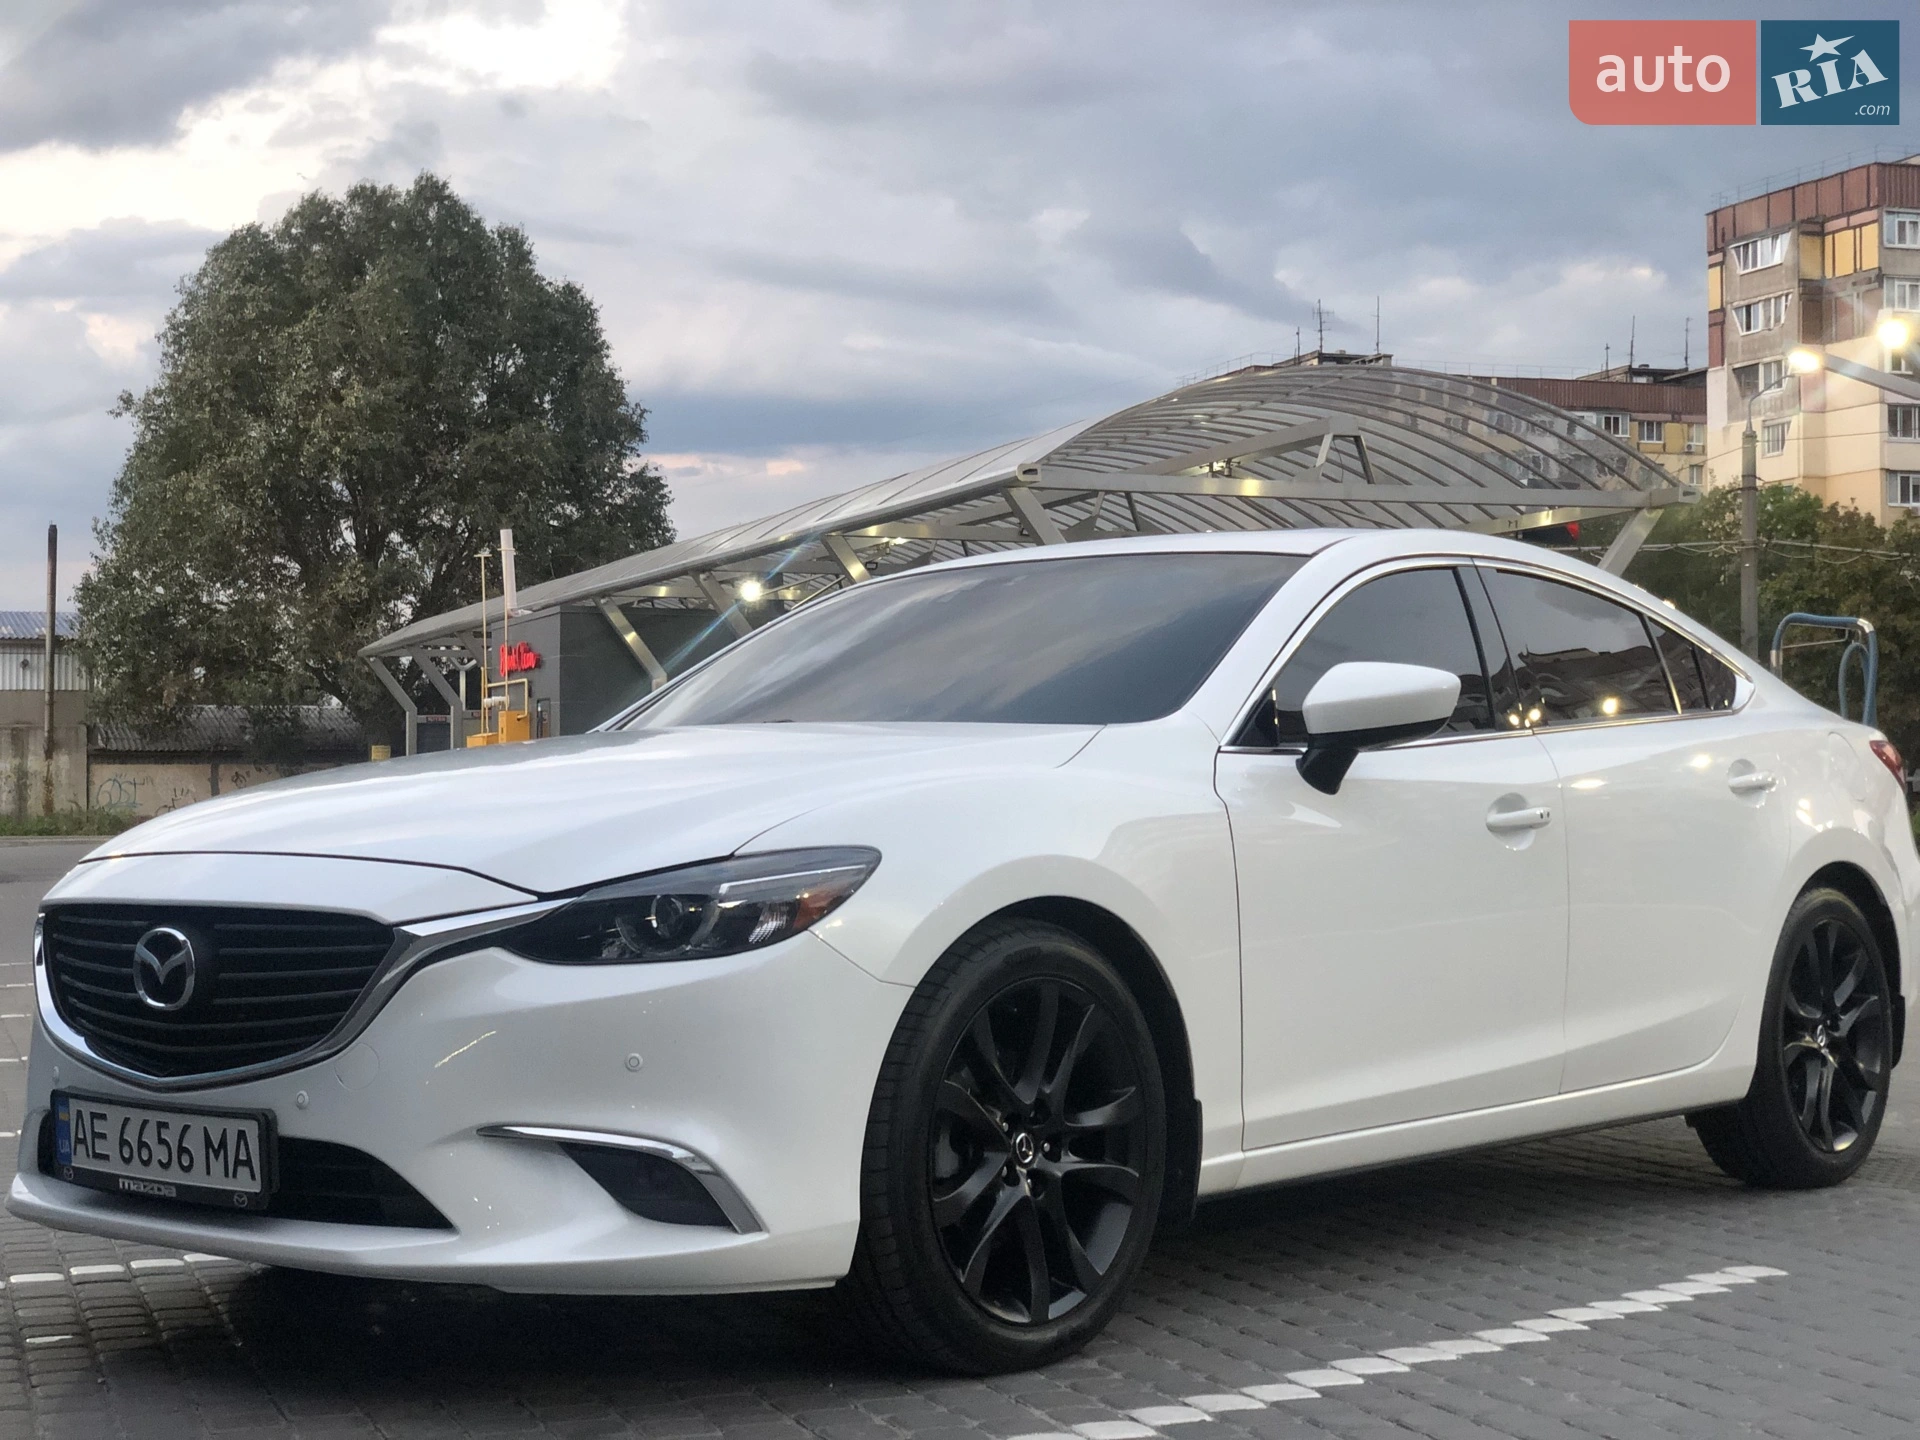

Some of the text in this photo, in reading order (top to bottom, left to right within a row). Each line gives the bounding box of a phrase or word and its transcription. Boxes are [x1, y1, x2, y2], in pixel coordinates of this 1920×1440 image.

[73, 1109, 256, 1181] AE 6656 MA
